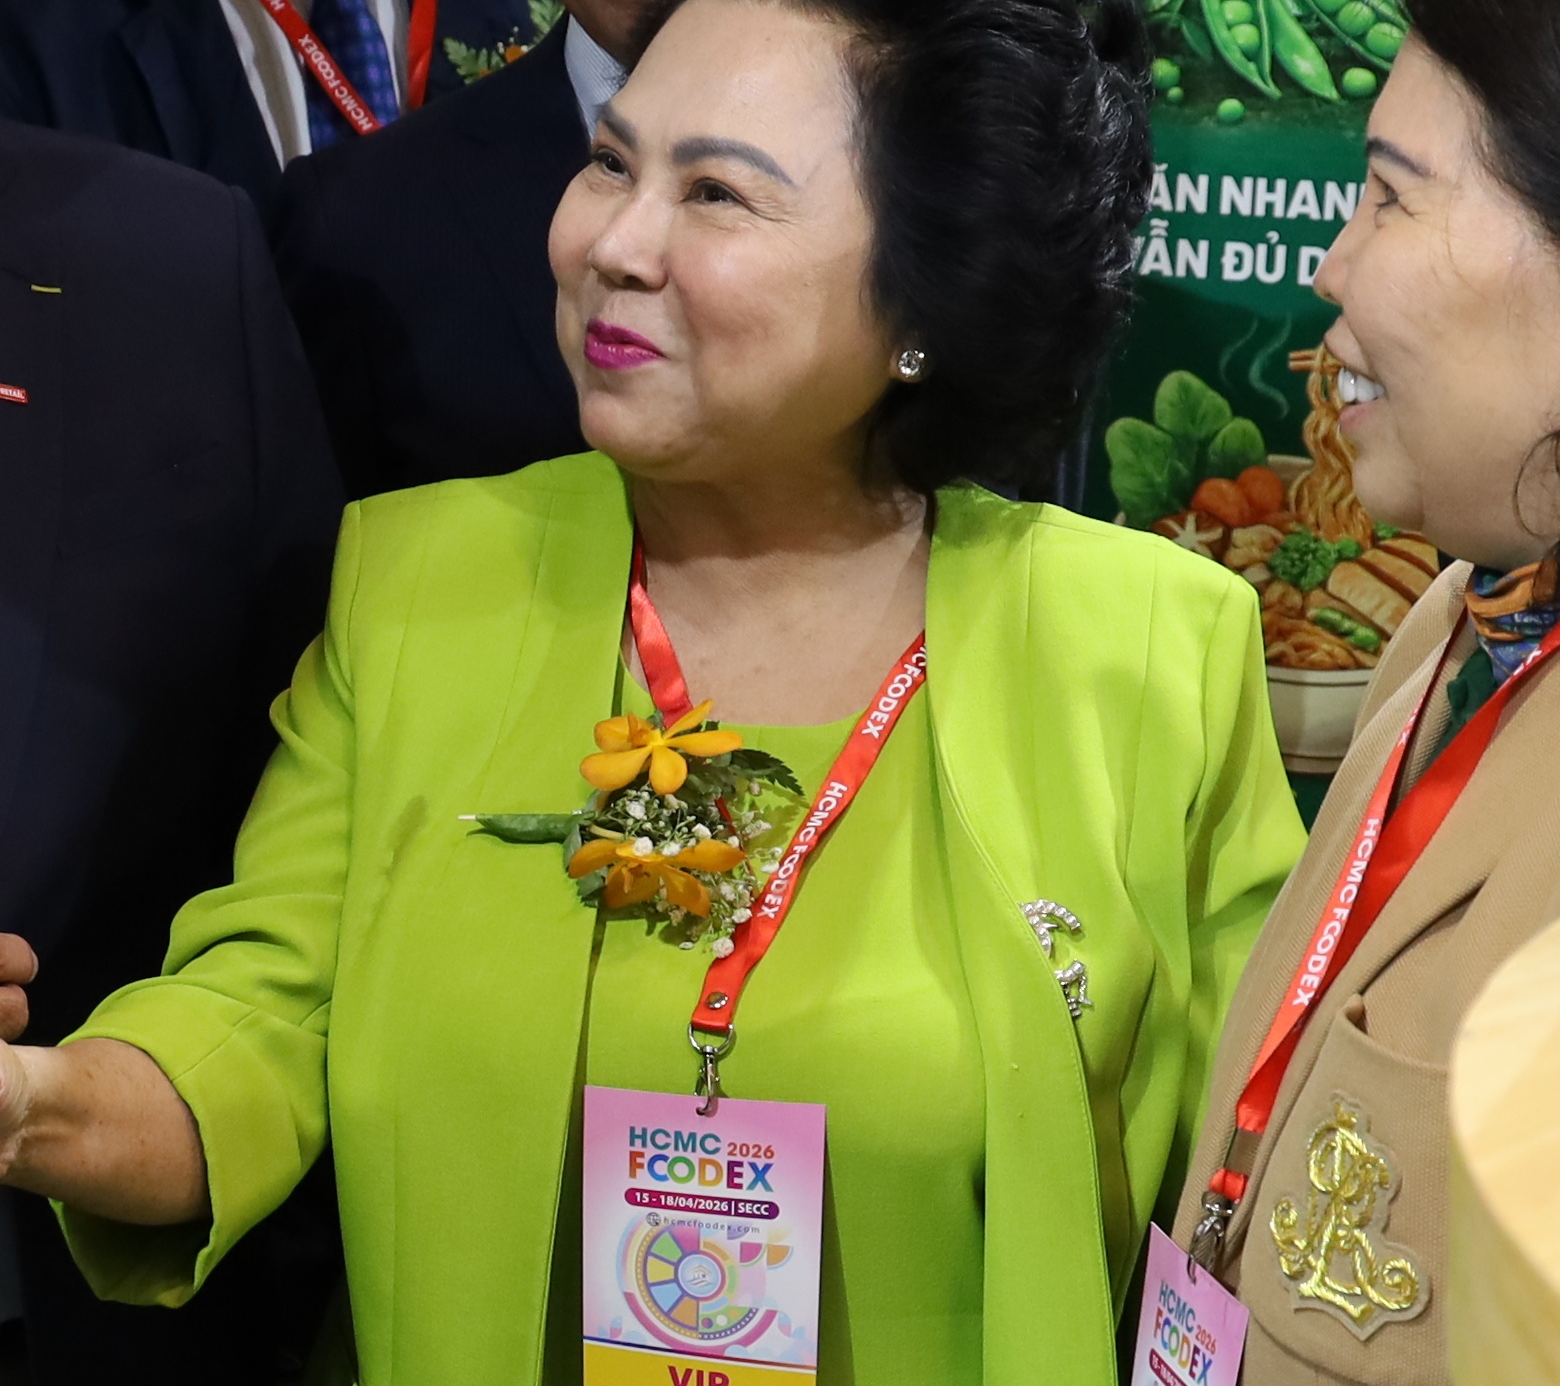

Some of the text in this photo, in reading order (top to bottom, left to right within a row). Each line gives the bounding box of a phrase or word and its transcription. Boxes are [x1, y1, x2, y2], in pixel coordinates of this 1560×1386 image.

[332, 82, 375, 133] HCMC
[1219, 173, 1367, 223] NHAN
[1221, 230, 1288, 285] ĐỦ
[795, 779, 850, 847] HCMC
[1335, 816, 1382, 907] HCMC
[628, 1125, 776, 1161] HCMC 2026
[635, 1191, 650, 1204] 15
[659, 1194, 729, 1212] 18/04/2026
[737, 1202, 770, 1216] SECC
[1158, 1280, 1219, 1356] HCMC 2026
